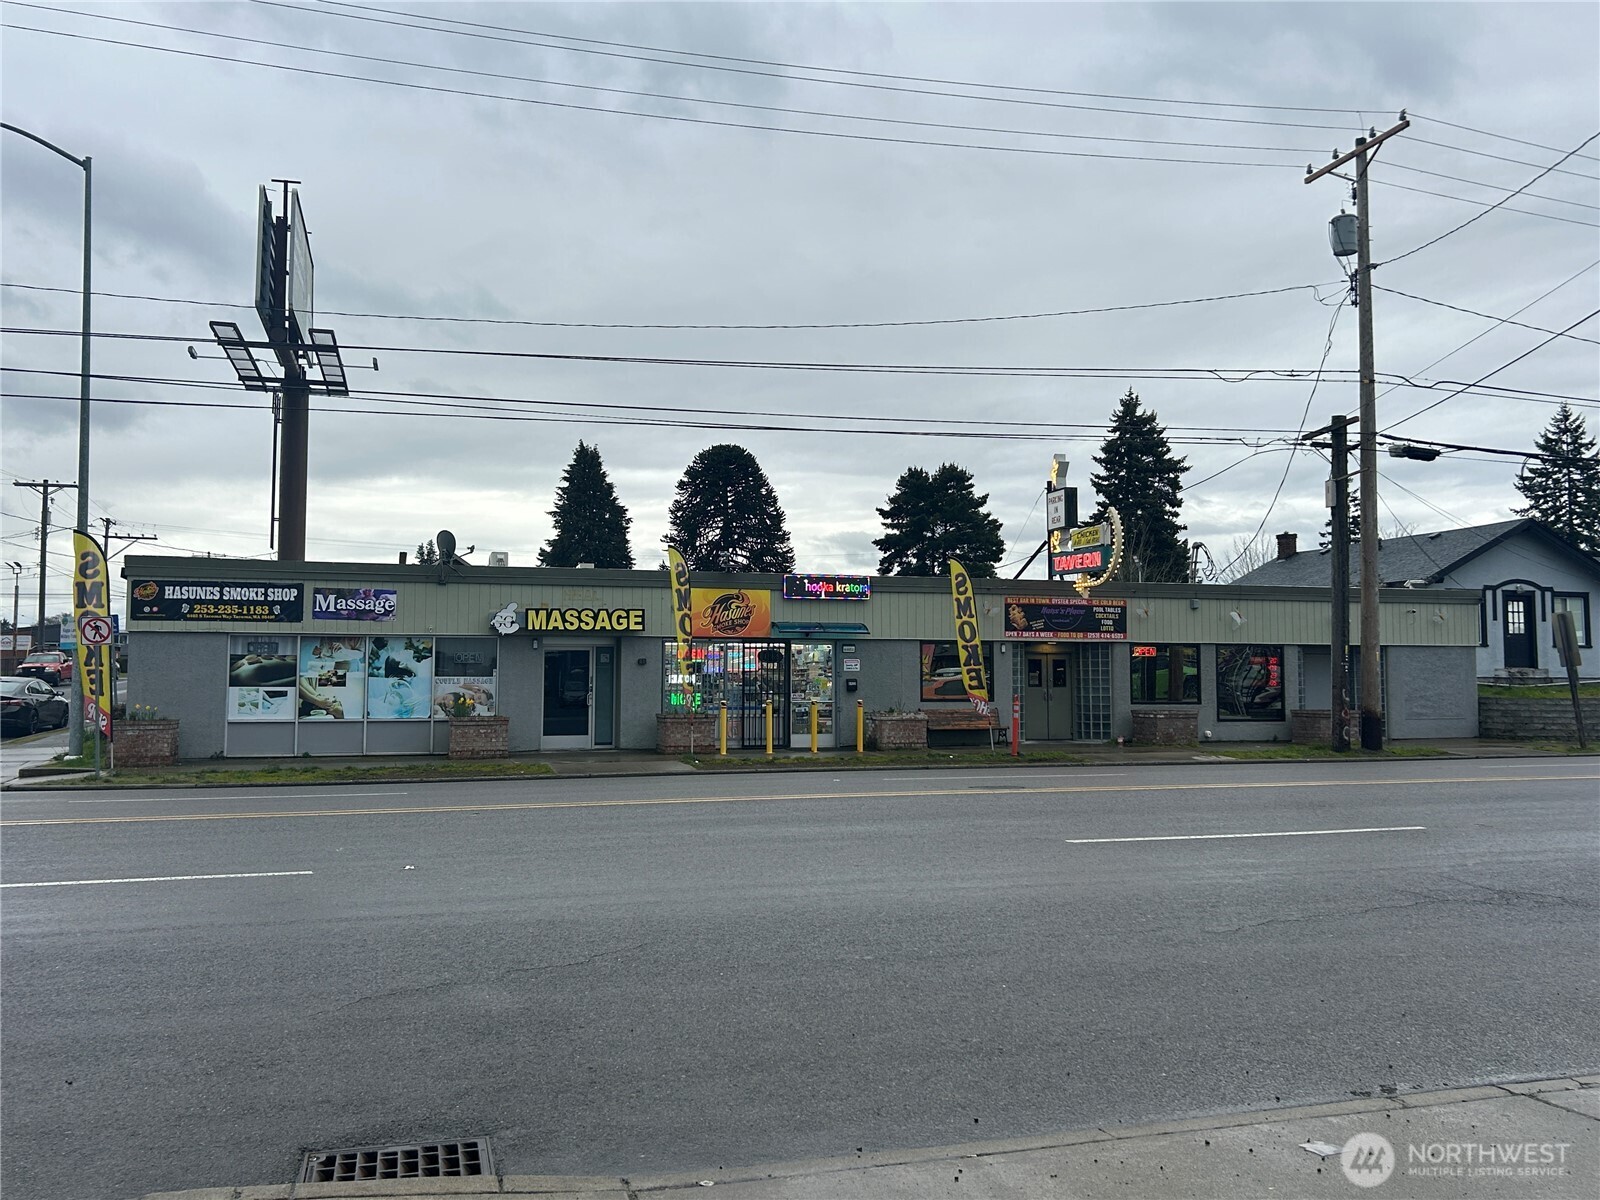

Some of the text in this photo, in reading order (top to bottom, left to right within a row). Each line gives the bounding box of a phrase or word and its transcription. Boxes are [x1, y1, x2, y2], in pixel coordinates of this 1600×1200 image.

[1048, 494, 1064, 504] PARKING
[1053, 506, 1059, 514] IN
[1051, 515, 1062, 525] REAR
[1052, 551, 1102, 571] TAVERN
[164, 586, 220, 600] HASUNES
[222, 587, 264, 601] SMOKE
[267, 588, 298, 601] SHOP
[314, 593, 395, 614] Massage
[193, 604, 269, 615] 253-235-1183
[527, 609, 644, 631] MASSAGE
[455, 652, 482, 662] OPEN
[1135, 648, 1155, 656] OPEN
